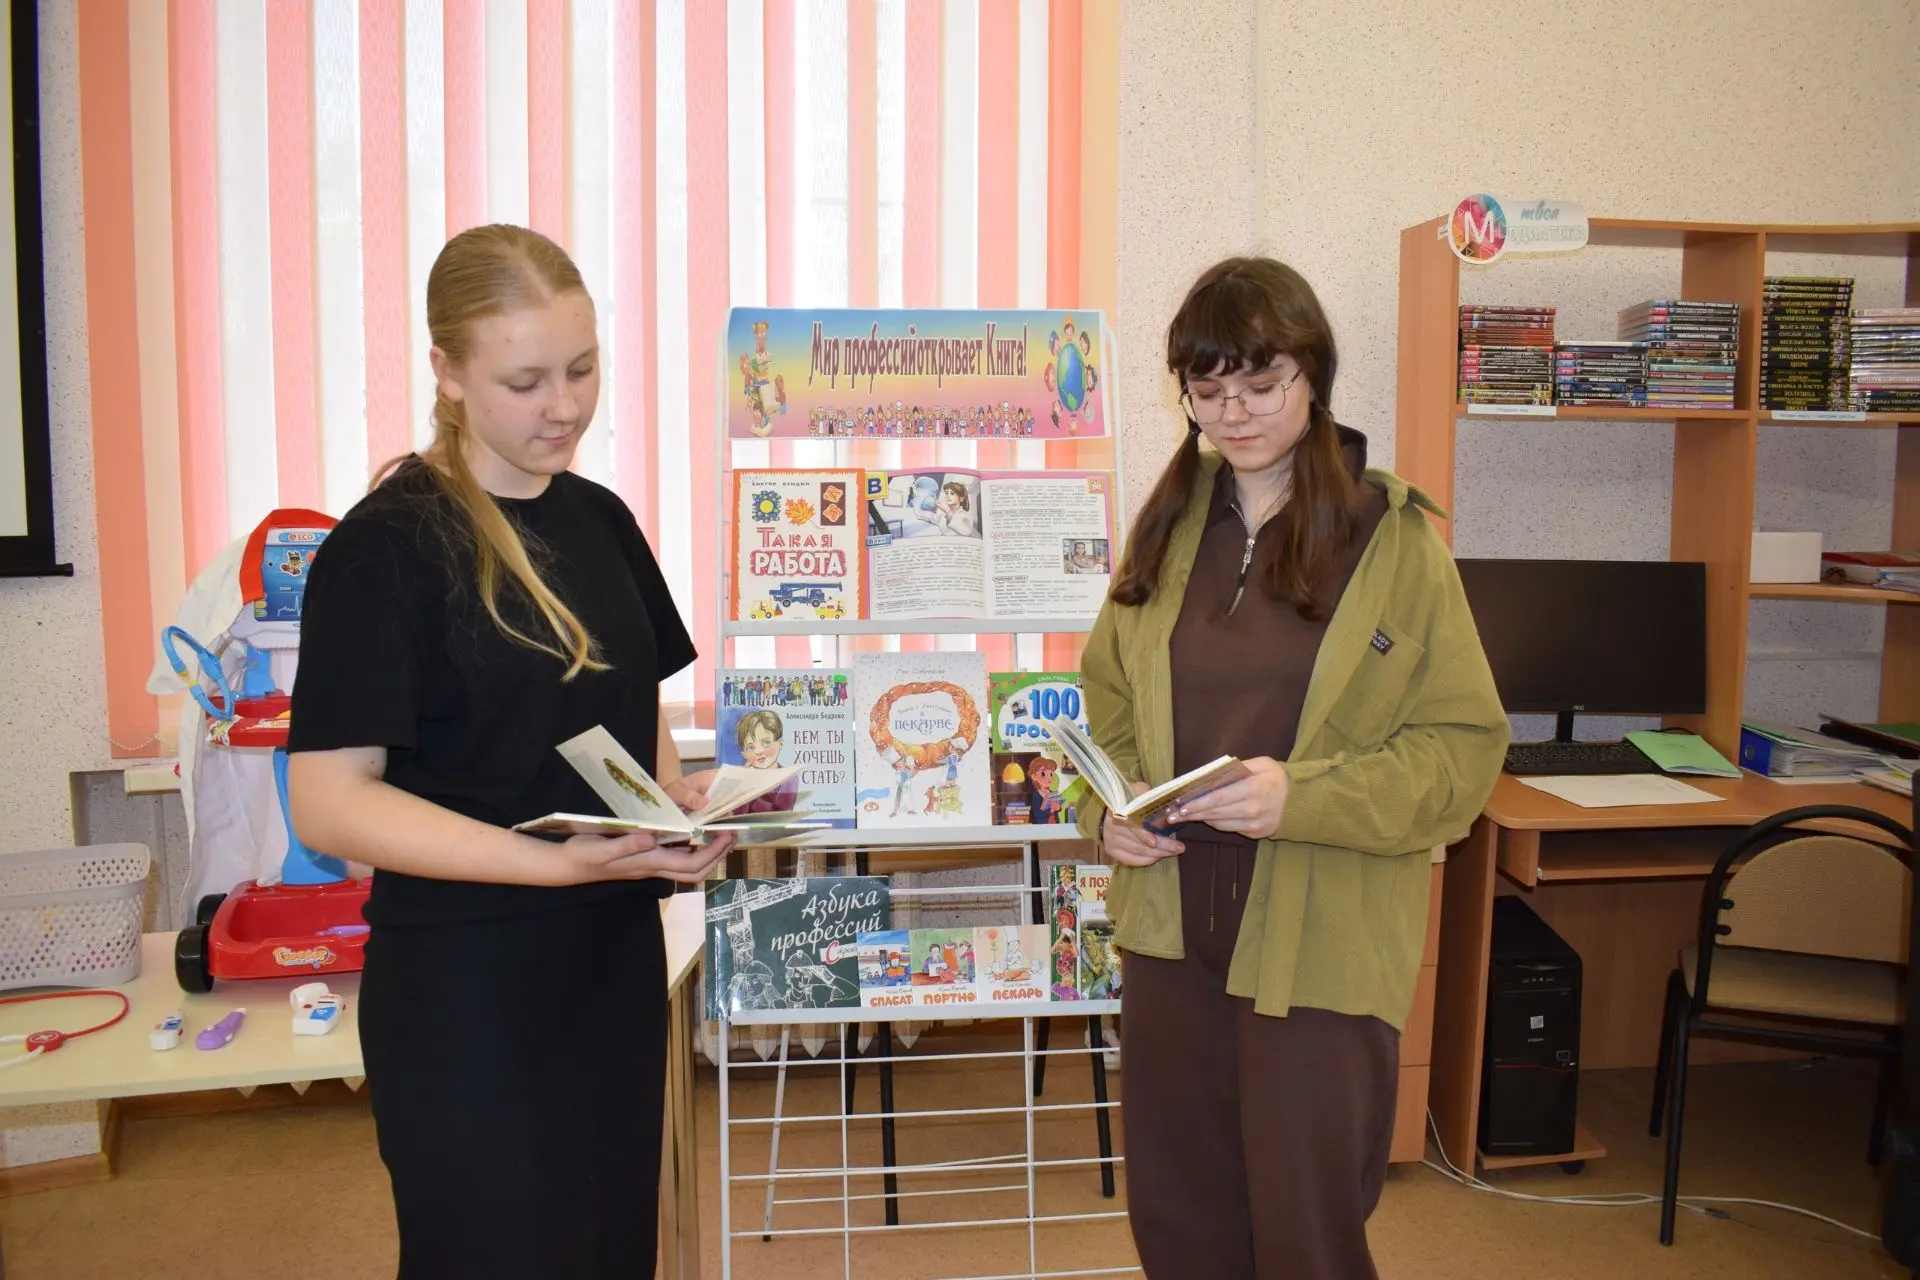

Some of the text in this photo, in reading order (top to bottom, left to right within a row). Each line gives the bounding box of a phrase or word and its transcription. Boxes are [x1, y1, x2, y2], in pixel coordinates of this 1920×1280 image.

[808, 321, 840, 389] Мир
[986, 322, 1028, 377] Книга!
[753, 551, 844, 575] РАБОТА
[1028, 687, 1080, 721] 100
[794, 730, 845, 745] КЕМ ТЫ
[792, 750, 845, 765] ХОЧЕШЬ
[801, 769, 846, 784] СТАТЬ?
[1089, 876, 1110, 888] ПОЗ
[801, 883, 881, 925] Азбука
[771, 909, 883, 961] профессий
